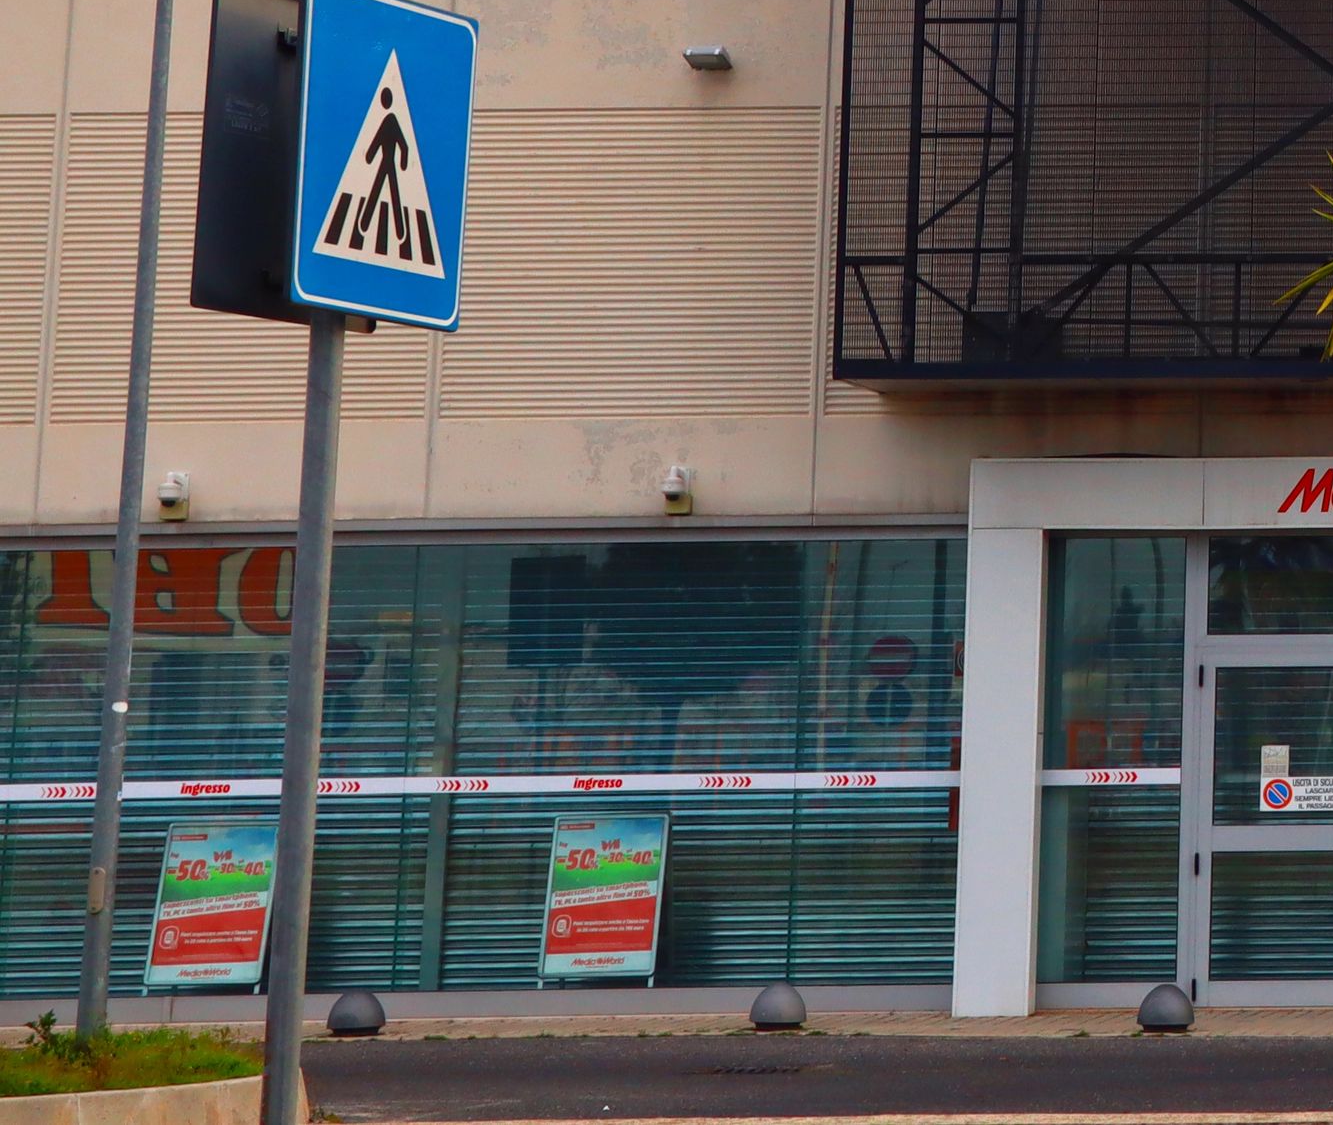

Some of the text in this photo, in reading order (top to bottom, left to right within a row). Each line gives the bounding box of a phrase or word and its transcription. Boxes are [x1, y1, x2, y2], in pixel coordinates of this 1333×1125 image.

[180, 782, 231, 796] ingresso
[573, 777, 623, 790] ingresso
[1292, 778, 1312, 787] USCITA
[1313, 778, 1319, 787] DI
